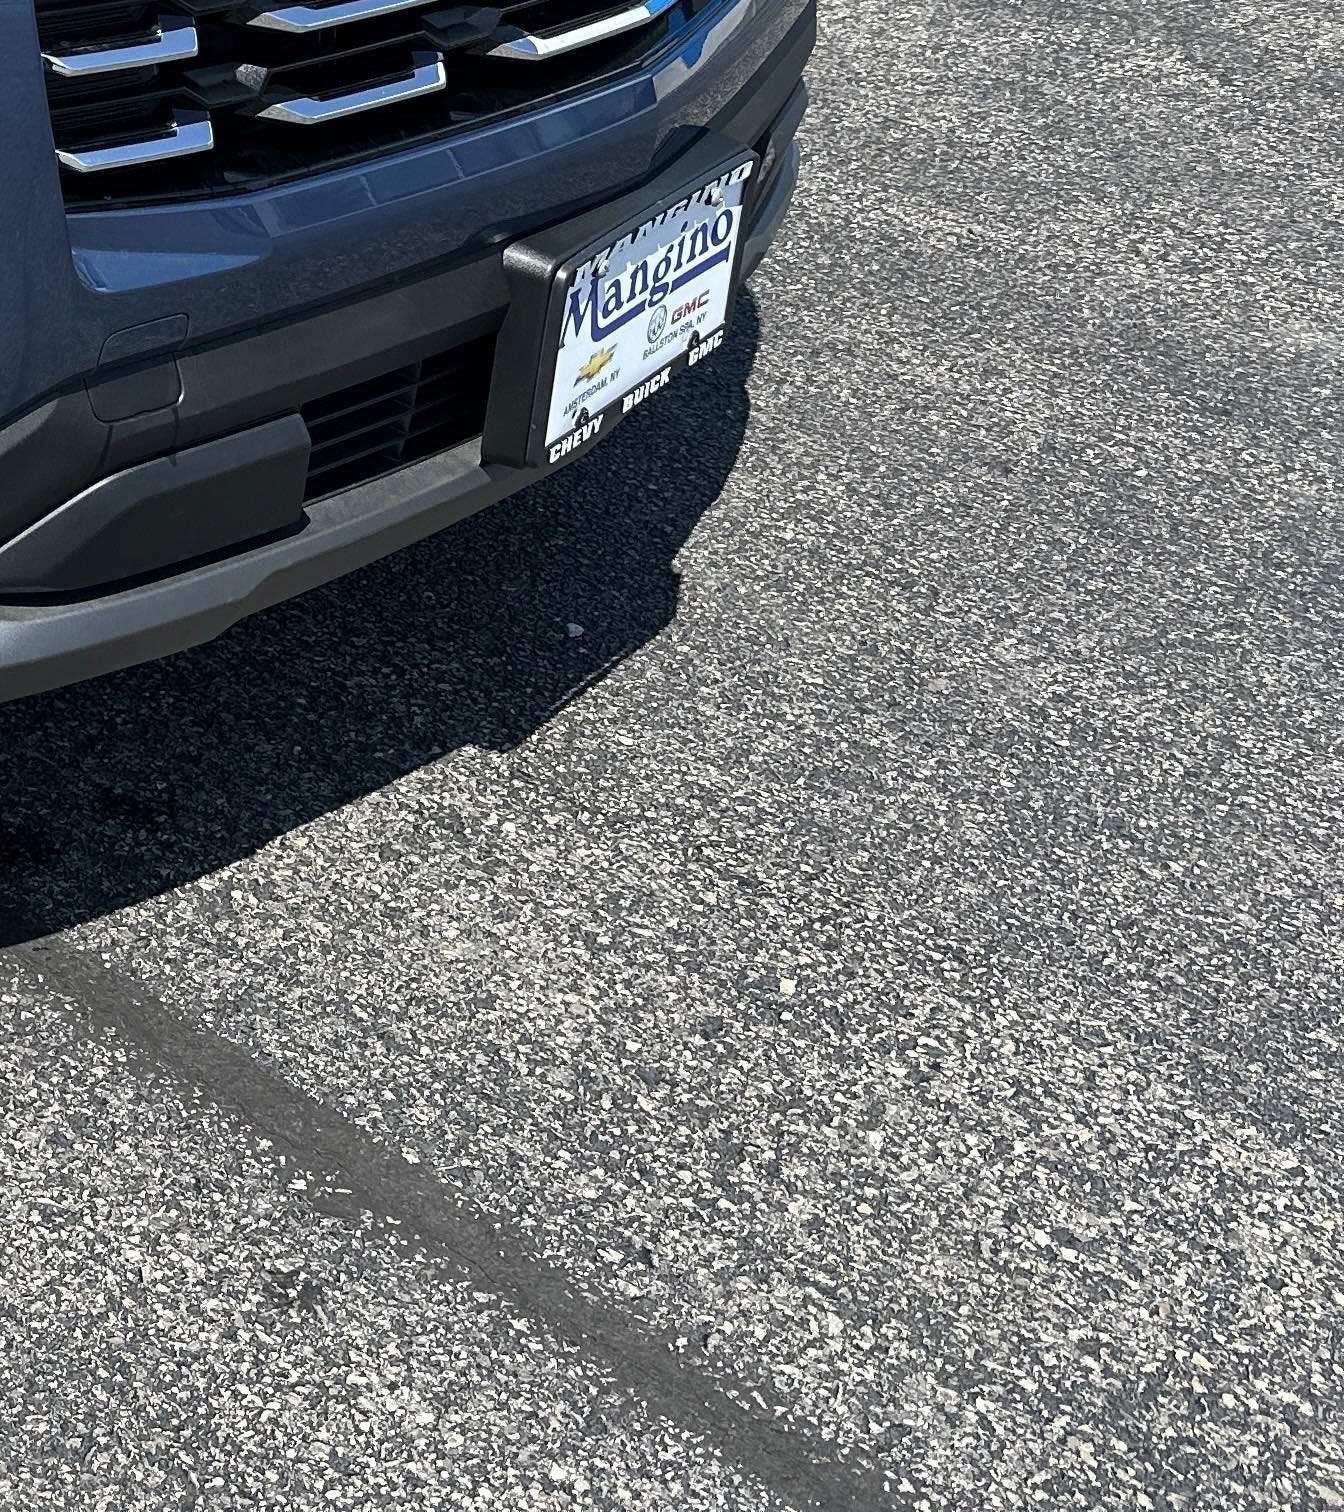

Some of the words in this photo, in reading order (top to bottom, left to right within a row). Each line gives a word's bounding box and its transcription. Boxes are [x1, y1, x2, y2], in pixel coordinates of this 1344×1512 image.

[559, 208, 734, 346] Mangino
[671, 288, 711, 325] GMC
[549, 414, 604, 464] CHEVY
[622, 366, 672, 414] BUICK
[688, 329, 724, 367] GMC
